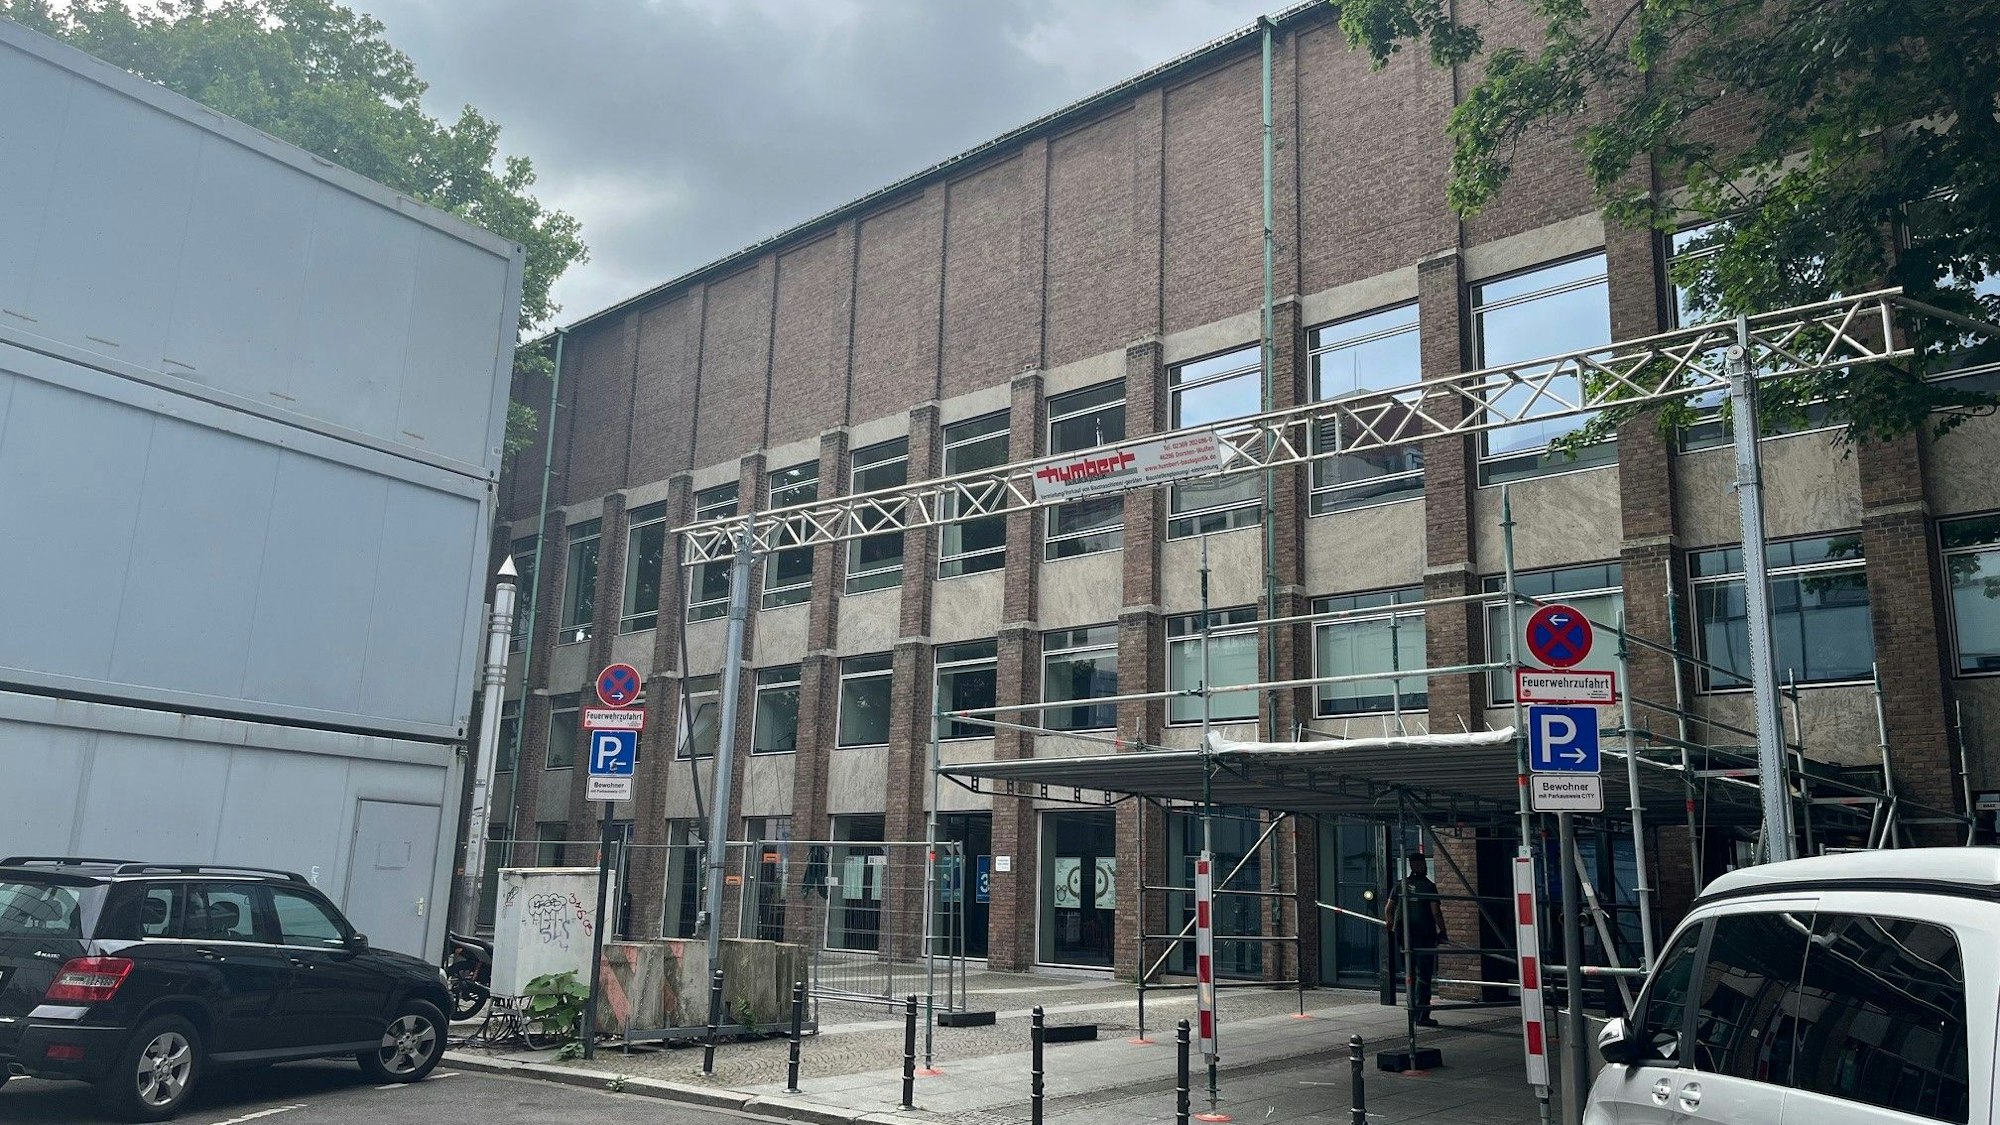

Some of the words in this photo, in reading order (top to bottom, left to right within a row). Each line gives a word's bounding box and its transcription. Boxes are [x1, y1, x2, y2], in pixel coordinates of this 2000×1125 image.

[1036, 451, 1136, 483] humbert
[1522, 675, 1609, 689] Feuerwehrzufahrt
[586, 711, 642, 721] Feuerwehrzufahrt
[1541, 714, 1577, 763] P
[597, 736, 622, 769] P
[594, 781, 625, 789] Bewohner
[1542, 782, 1589, 791] Bewohner
